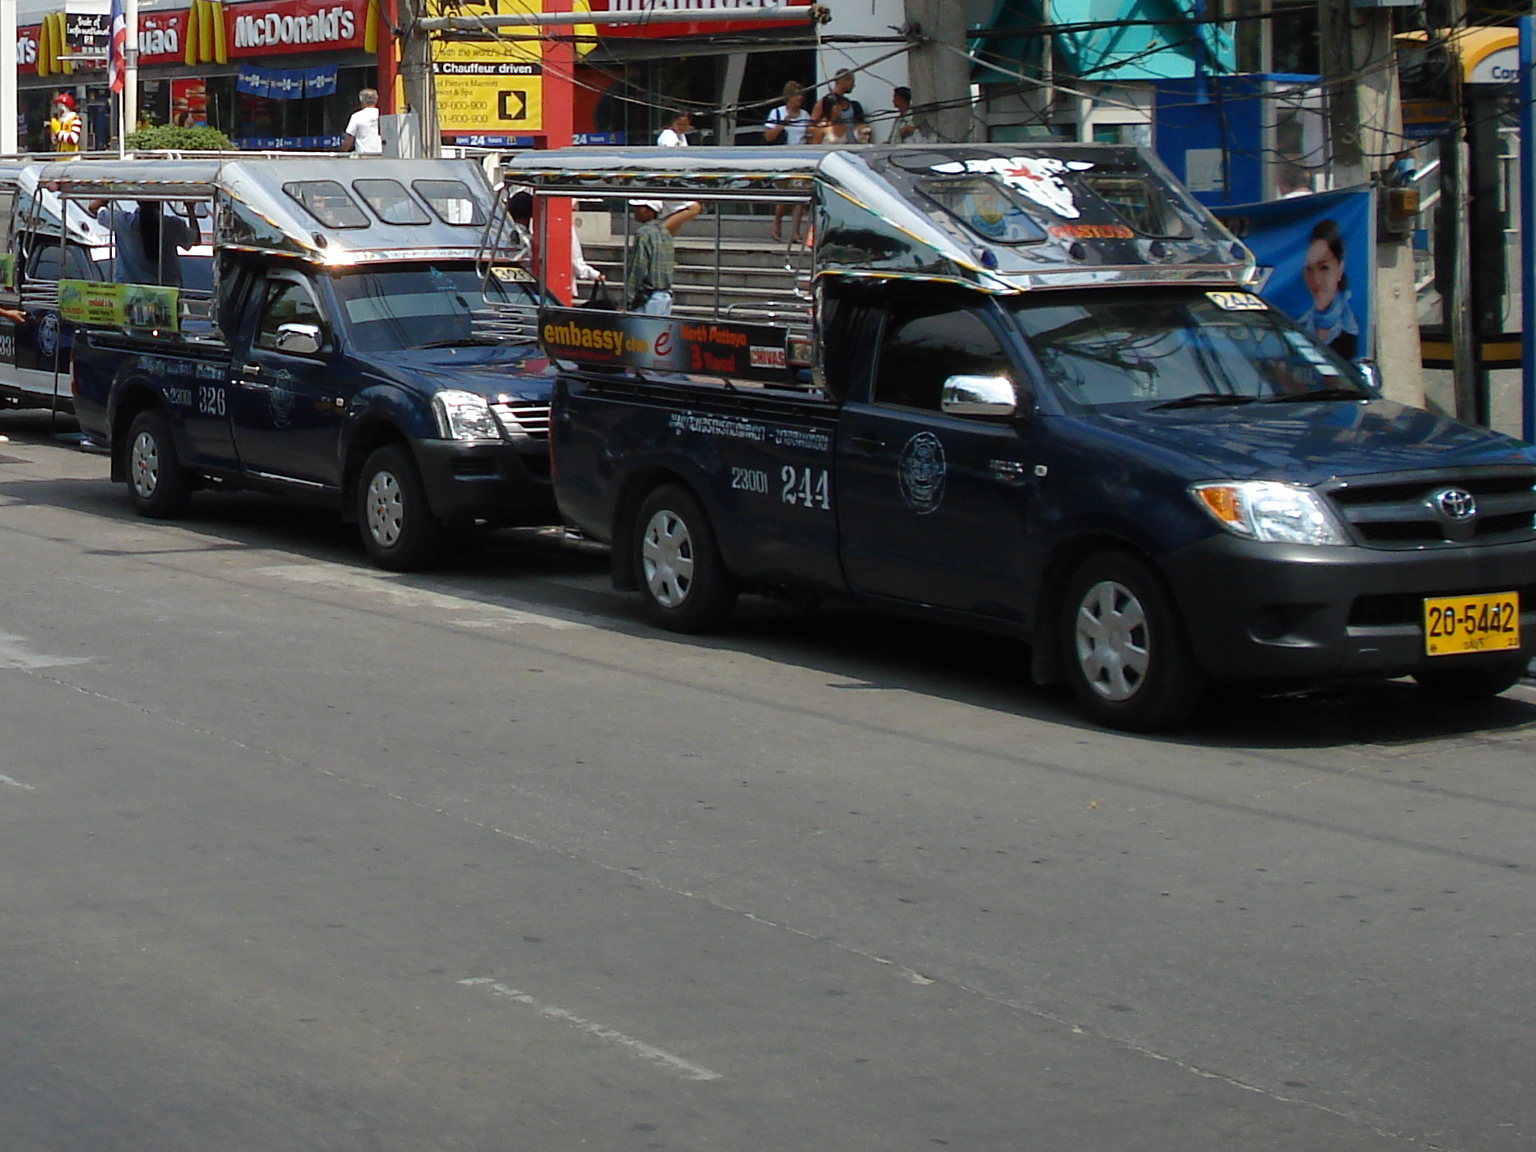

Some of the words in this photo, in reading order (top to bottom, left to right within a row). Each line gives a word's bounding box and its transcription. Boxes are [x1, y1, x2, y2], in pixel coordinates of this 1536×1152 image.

[234, 4, 355, 48] McDonald's
[457, 48, 471, 57] the
[442, 62, 496, 74] Chauffeur
[498, 62, 533, 74] driven
[470, 79, 498, 87] Marriott
[470, 134, 486, 146] 24
[572, 133, 588, 146] 24
[1212, 293, 1265, 312] 244
[543, 320, 624, 357] embassy
[679, 323, 708, 343] North
[708, 325, 748, 349] Pattaya
[750, 349, 786, 367] CHIVAS
[198, 385, 237, 416] 326
[731, 466, 769, 495] 23001
[780, 464, 831, 511] 244
[1428, 600, 1515, 638] 20-5442
